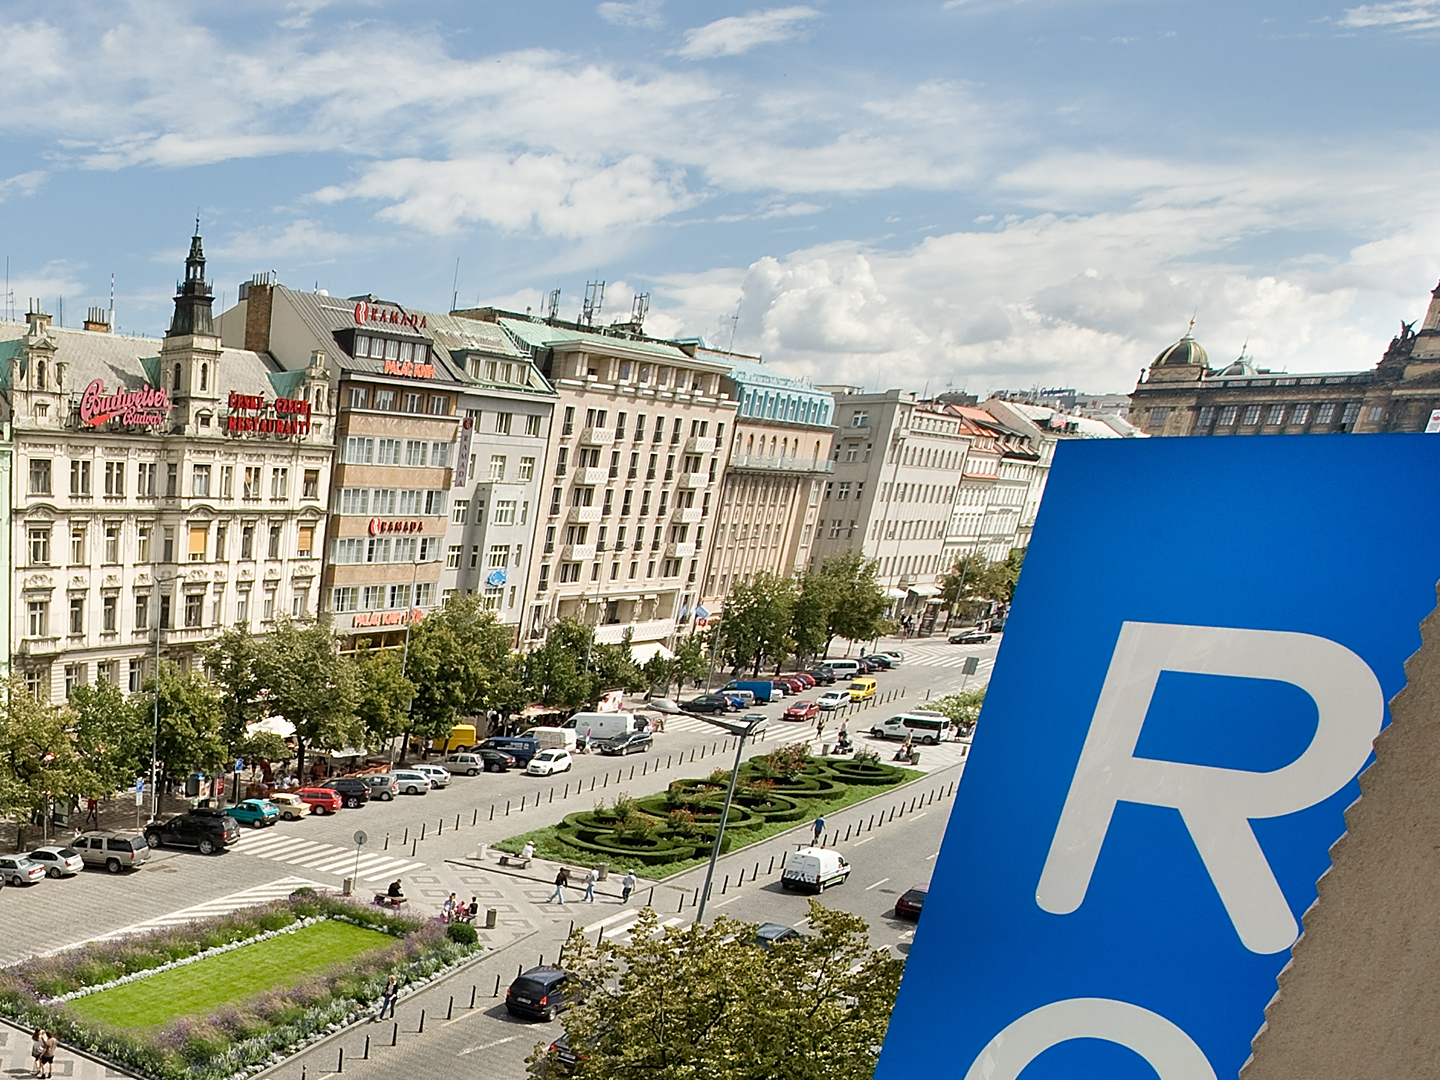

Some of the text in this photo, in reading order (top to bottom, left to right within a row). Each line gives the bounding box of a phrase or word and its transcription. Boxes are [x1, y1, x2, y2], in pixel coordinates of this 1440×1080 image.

[371, 307, 427, 329] RAMADA
[81, 378, 169, 421] Budweiser
[275, 397, 308, 414] CZECH
[122, 406, 162, 425] Budvar
[228, 416, 306, 435] RESTAURANT
[457, 435, 469, 487] RAMADA
[380, 521, 424, 533] RAMADA
